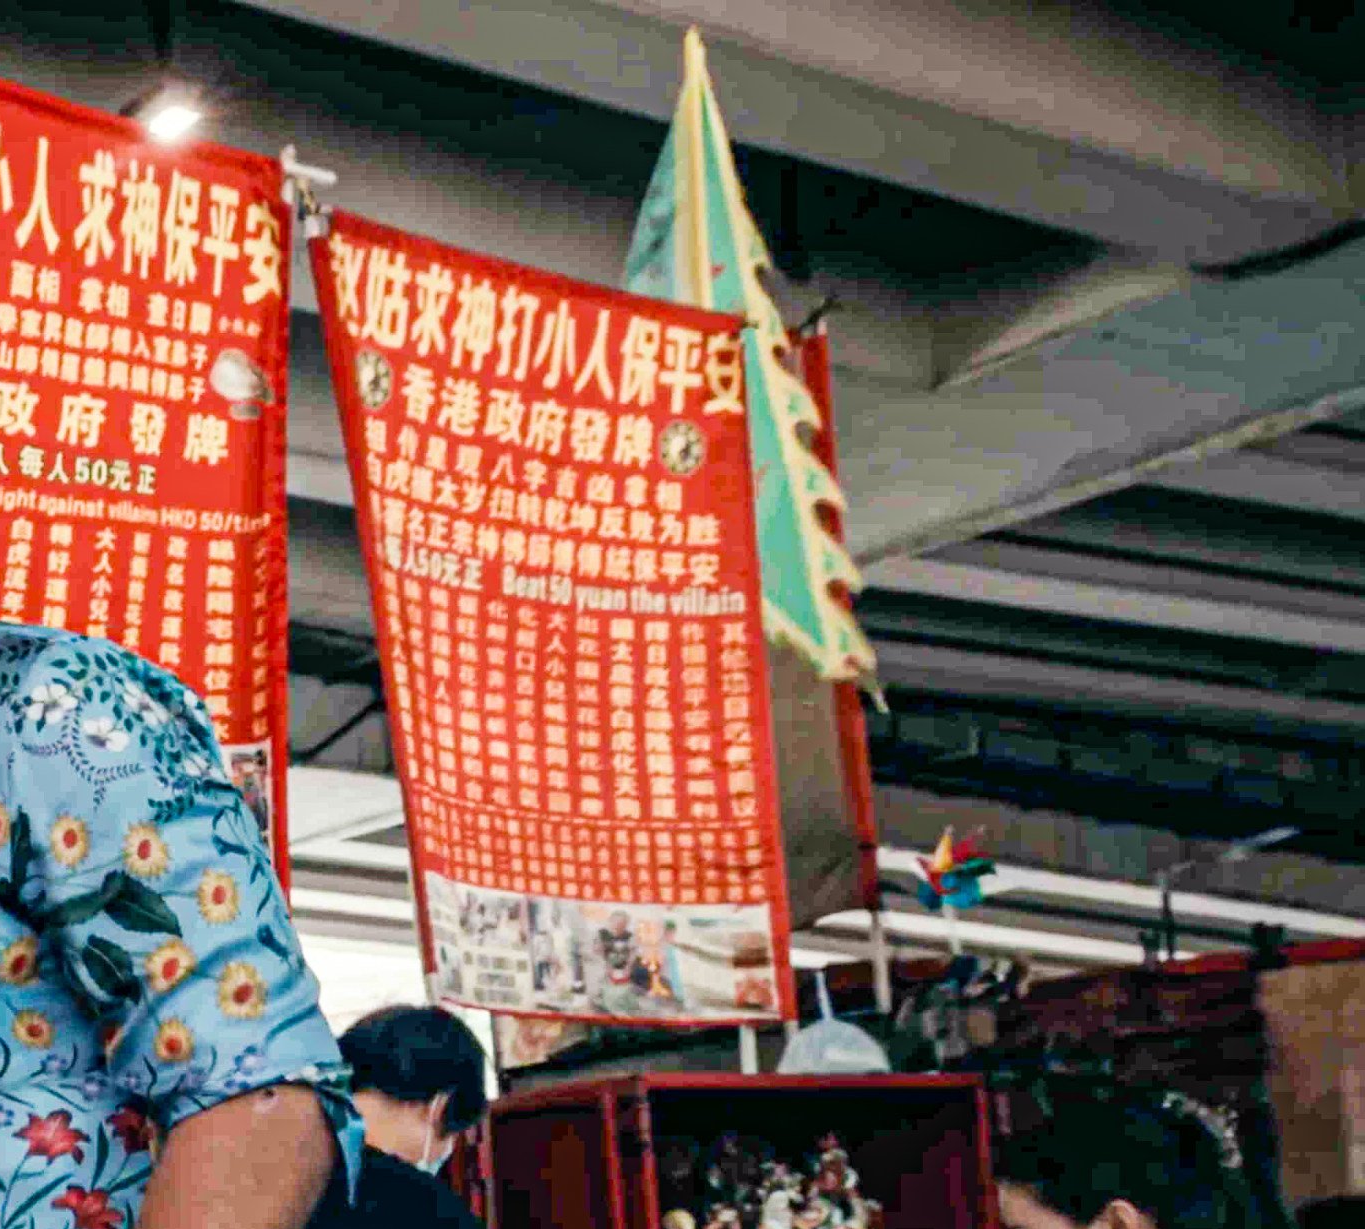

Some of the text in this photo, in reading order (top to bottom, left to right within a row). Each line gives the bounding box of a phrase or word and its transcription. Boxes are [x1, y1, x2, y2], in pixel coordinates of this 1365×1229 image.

[73, 149, 283, 304] 求神保平安
[10, 259, 60, 304] 面相
[401, 361, 655, 469] 香港政府發牌
[38, 493, 104, 519] against
[160, 506, 197, 530] HKD
[574, 584, 627, 613] yuan
[630, 583, 666, 615] the
[670, 584, 746, 616] villain
